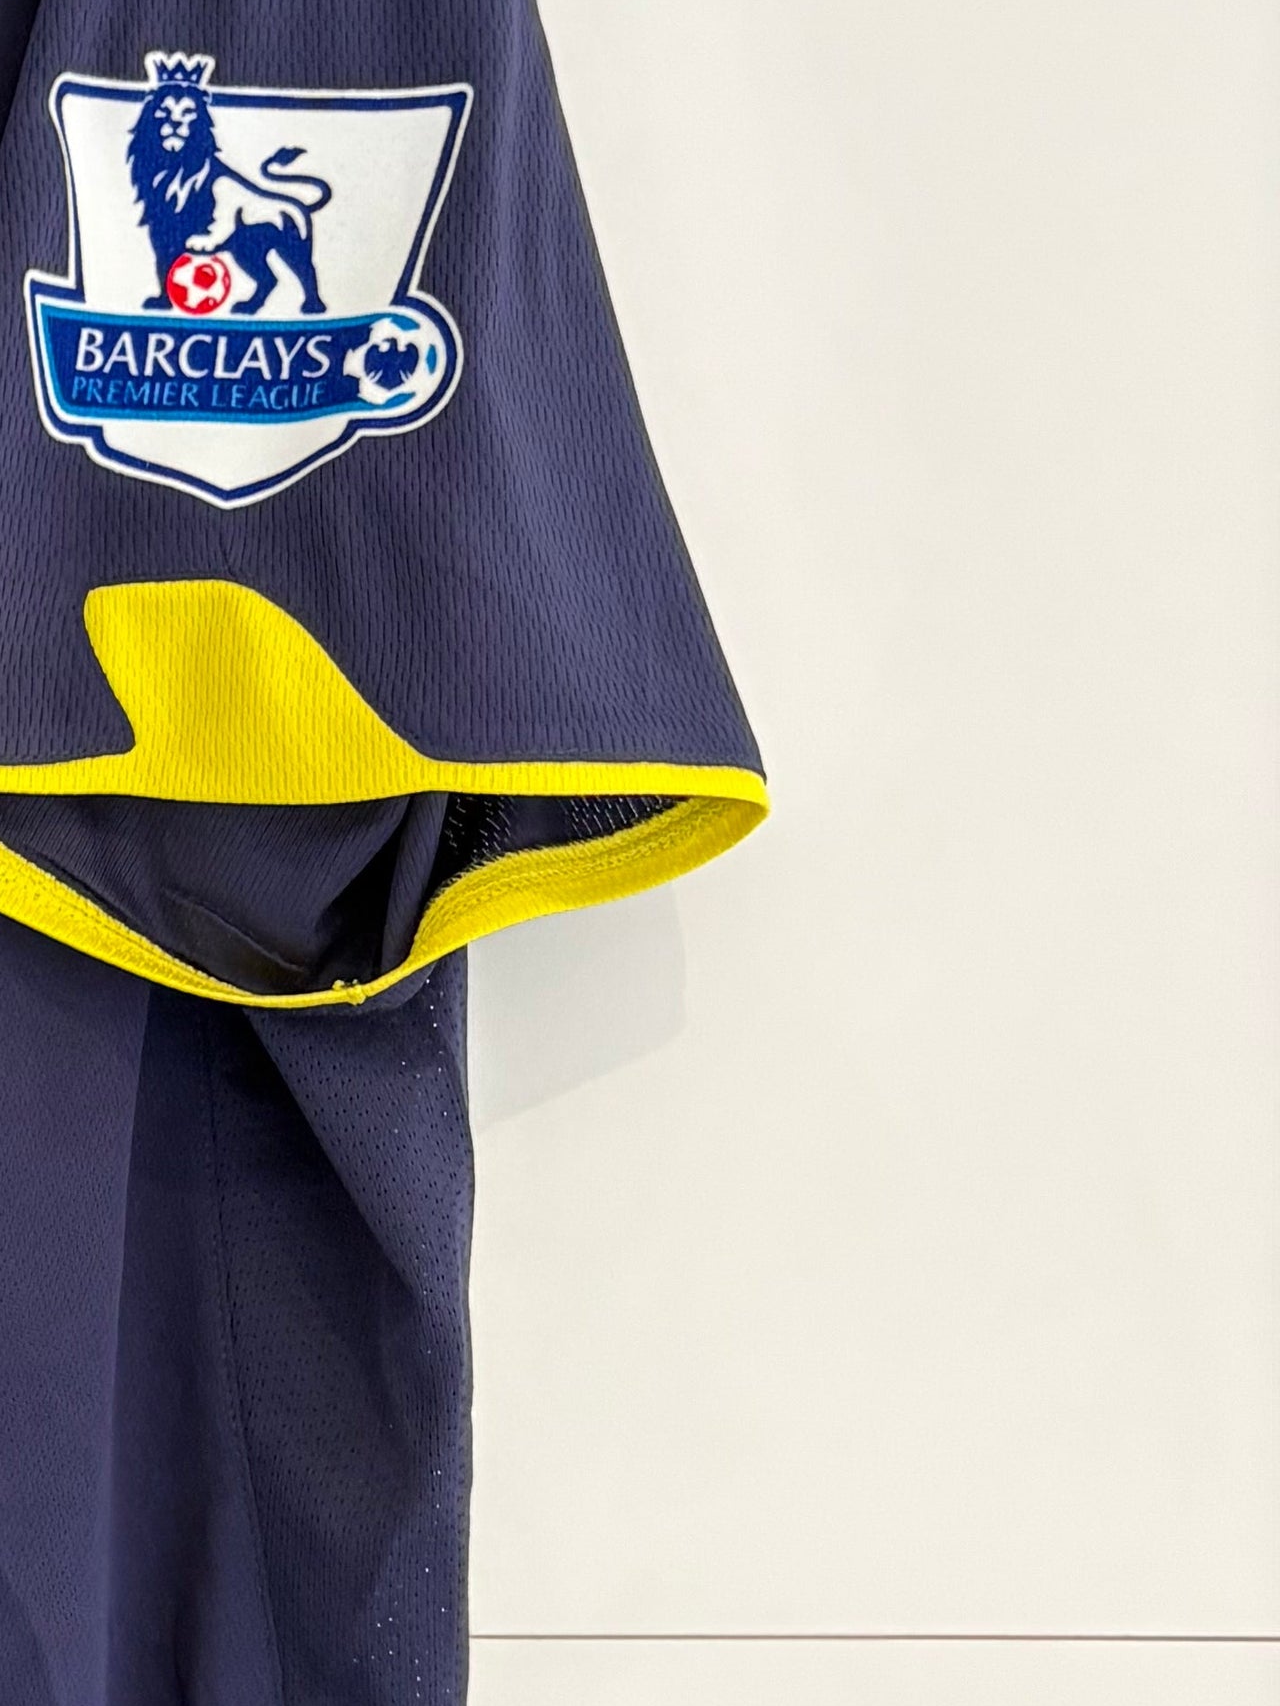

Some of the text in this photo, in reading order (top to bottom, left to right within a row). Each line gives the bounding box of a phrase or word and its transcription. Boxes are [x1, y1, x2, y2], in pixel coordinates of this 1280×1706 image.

[75, 327, 332, 380] BARCLAYS
[71, 375, 327, 410] PREMIER LEAGUE
